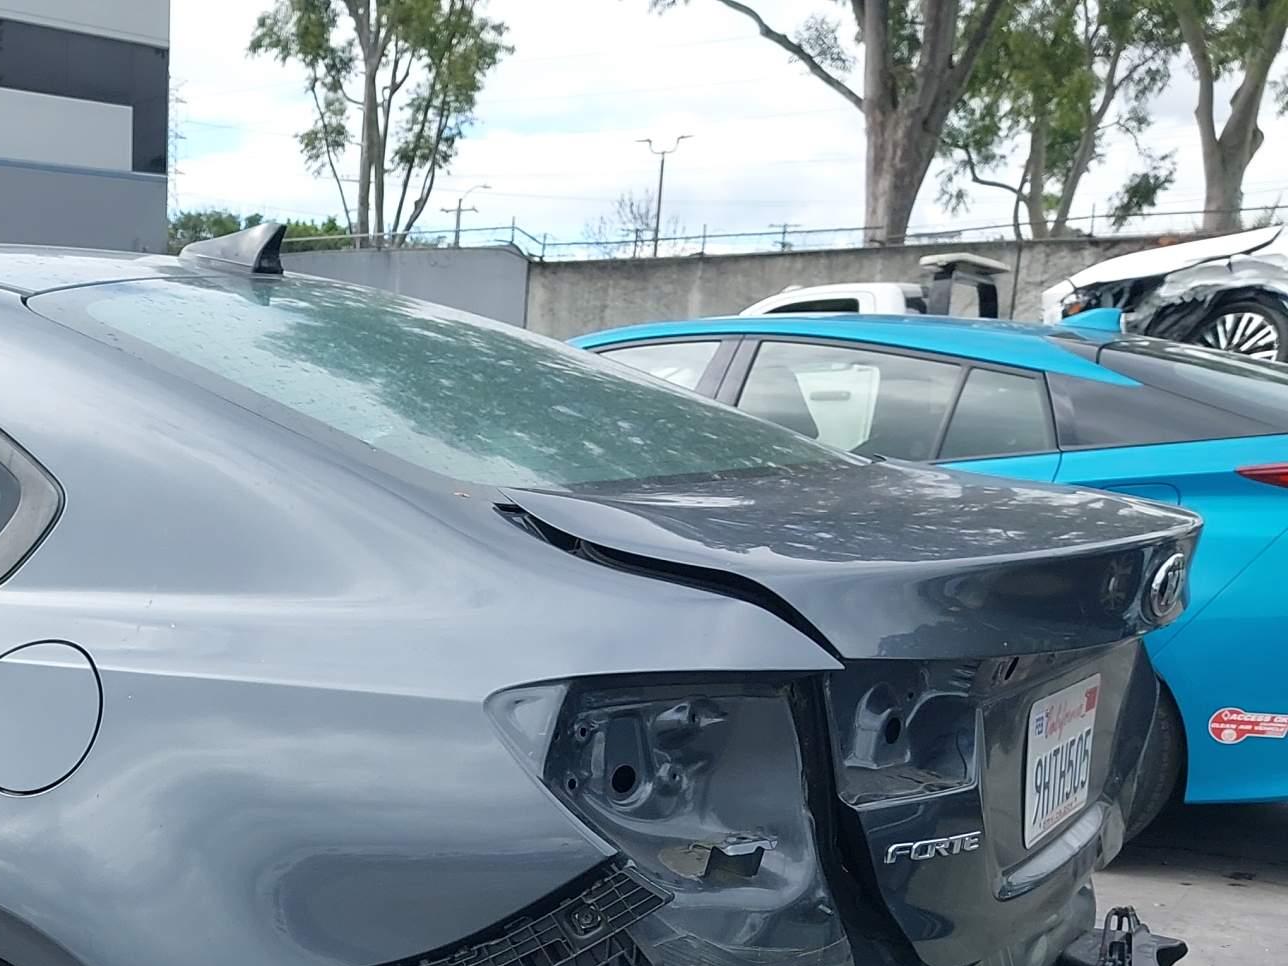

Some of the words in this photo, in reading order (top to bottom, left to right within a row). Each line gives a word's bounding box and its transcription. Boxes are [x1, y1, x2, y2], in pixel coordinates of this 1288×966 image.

[1230, 713, 1272, 722] ACCESS
[1032, 727, 1092, 826] 9HTH505
[883, 831, 982, 864] FORTE
